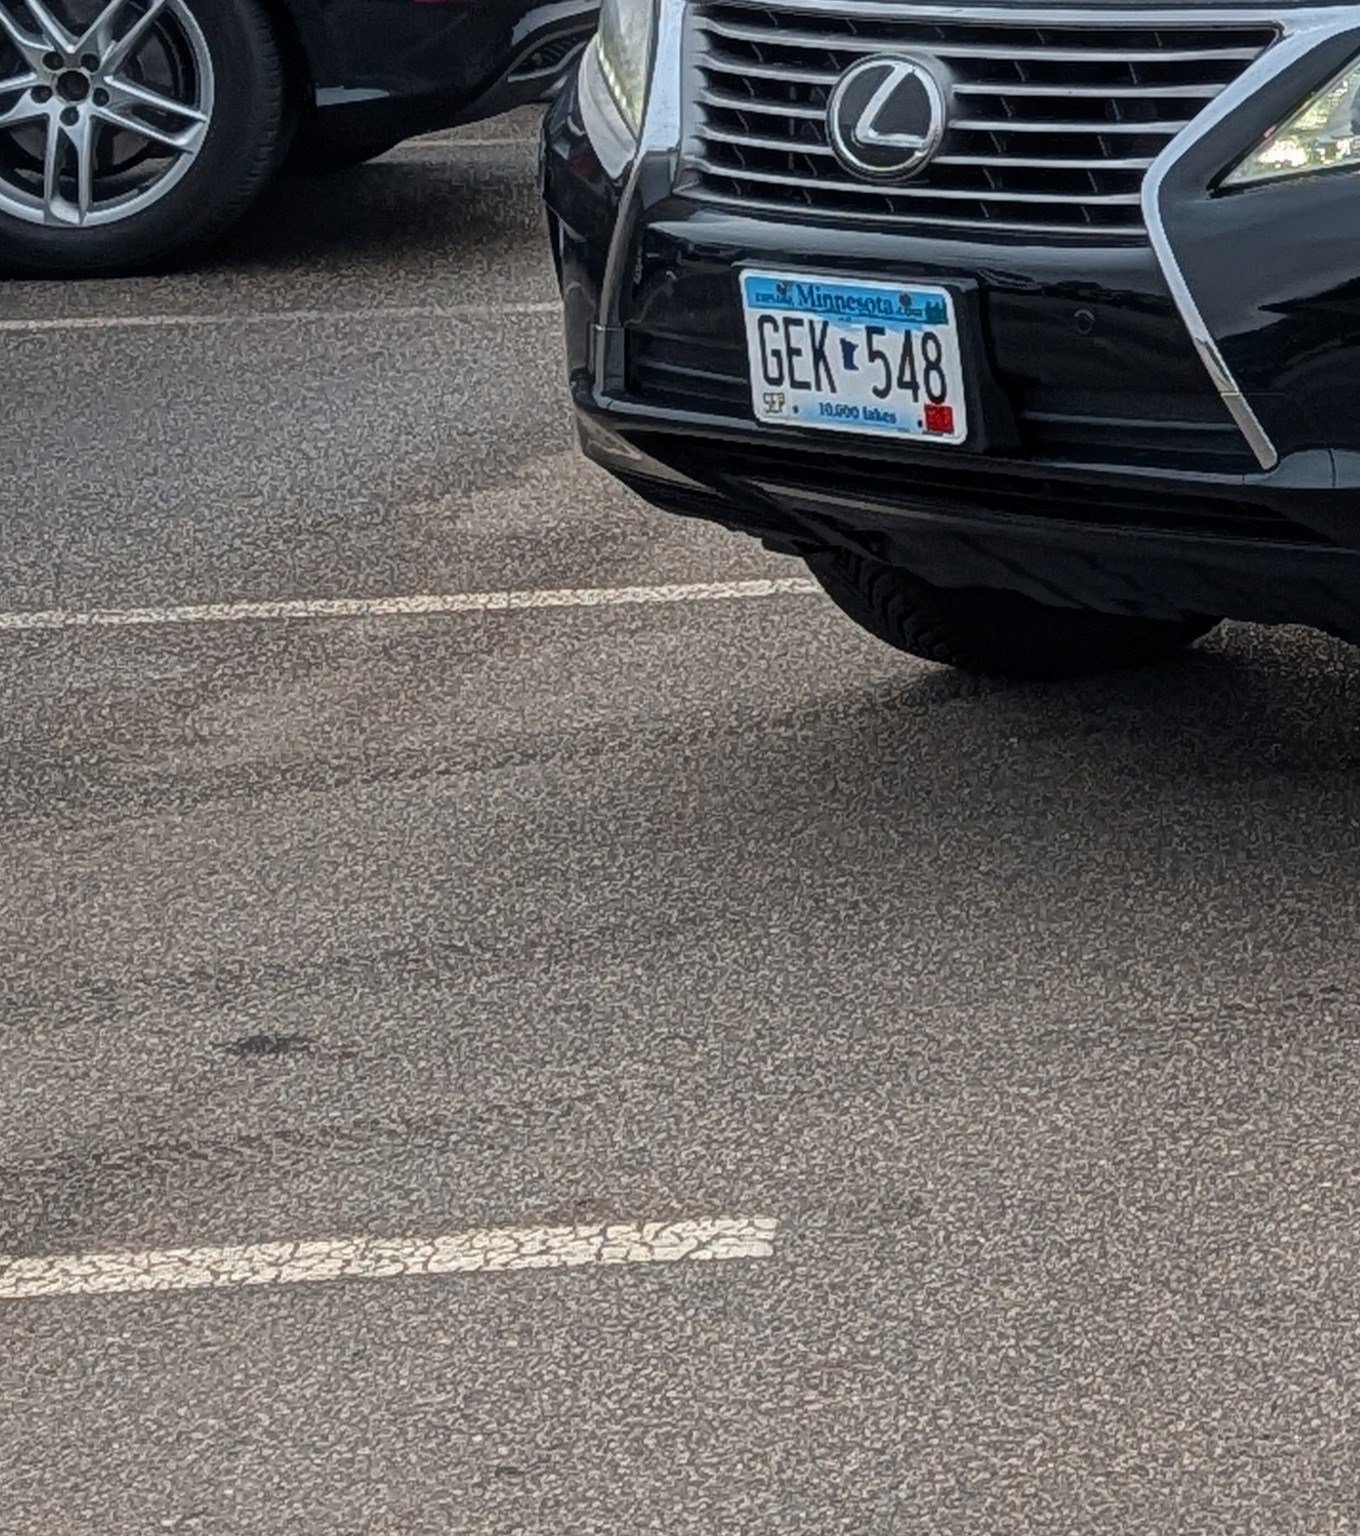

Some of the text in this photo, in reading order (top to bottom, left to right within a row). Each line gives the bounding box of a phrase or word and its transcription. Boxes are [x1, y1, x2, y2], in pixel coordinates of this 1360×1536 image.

[797, 283, 894, 316] Minnesota
[757, 314, 948, 405] GEK 548
